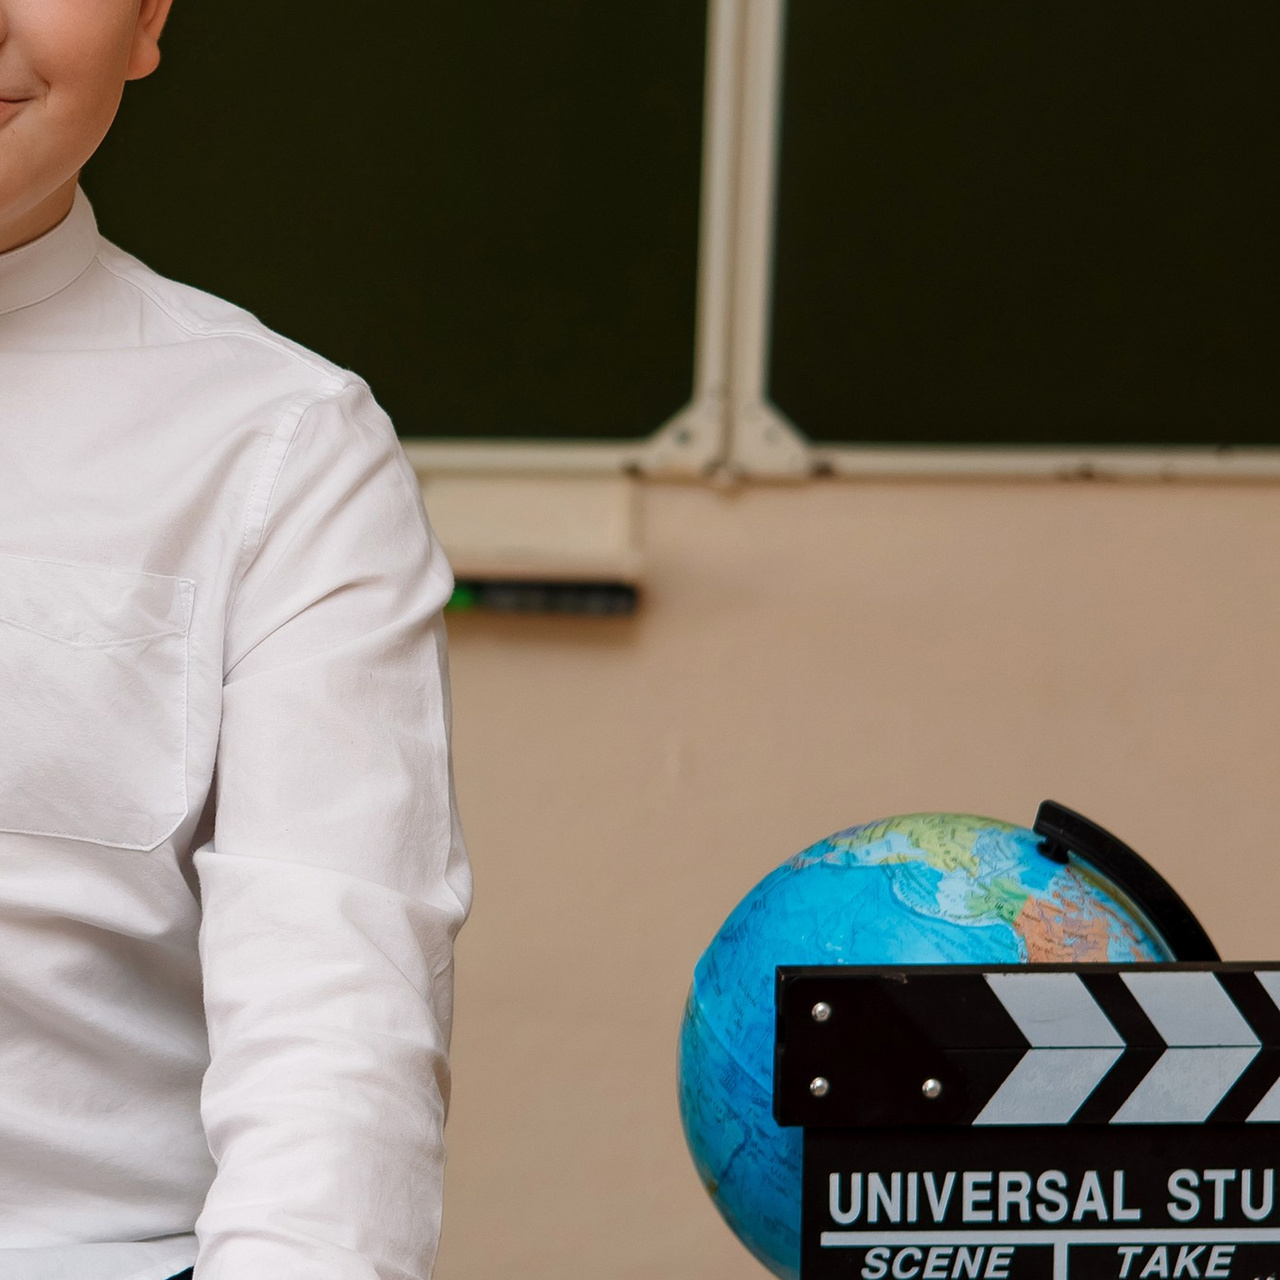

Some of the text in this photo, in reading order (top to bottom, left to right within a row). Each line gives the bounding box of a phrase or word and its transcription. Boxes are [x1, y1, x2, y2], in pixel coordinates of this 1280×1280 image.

[829, 1170, 1142, 1224] UNIVERSAL
[1167, 1168, 1276, 1221] STU
[860, 1246, 1015, 1280] SCENE
[1117, 1245, 1236, 1280] TAKE
